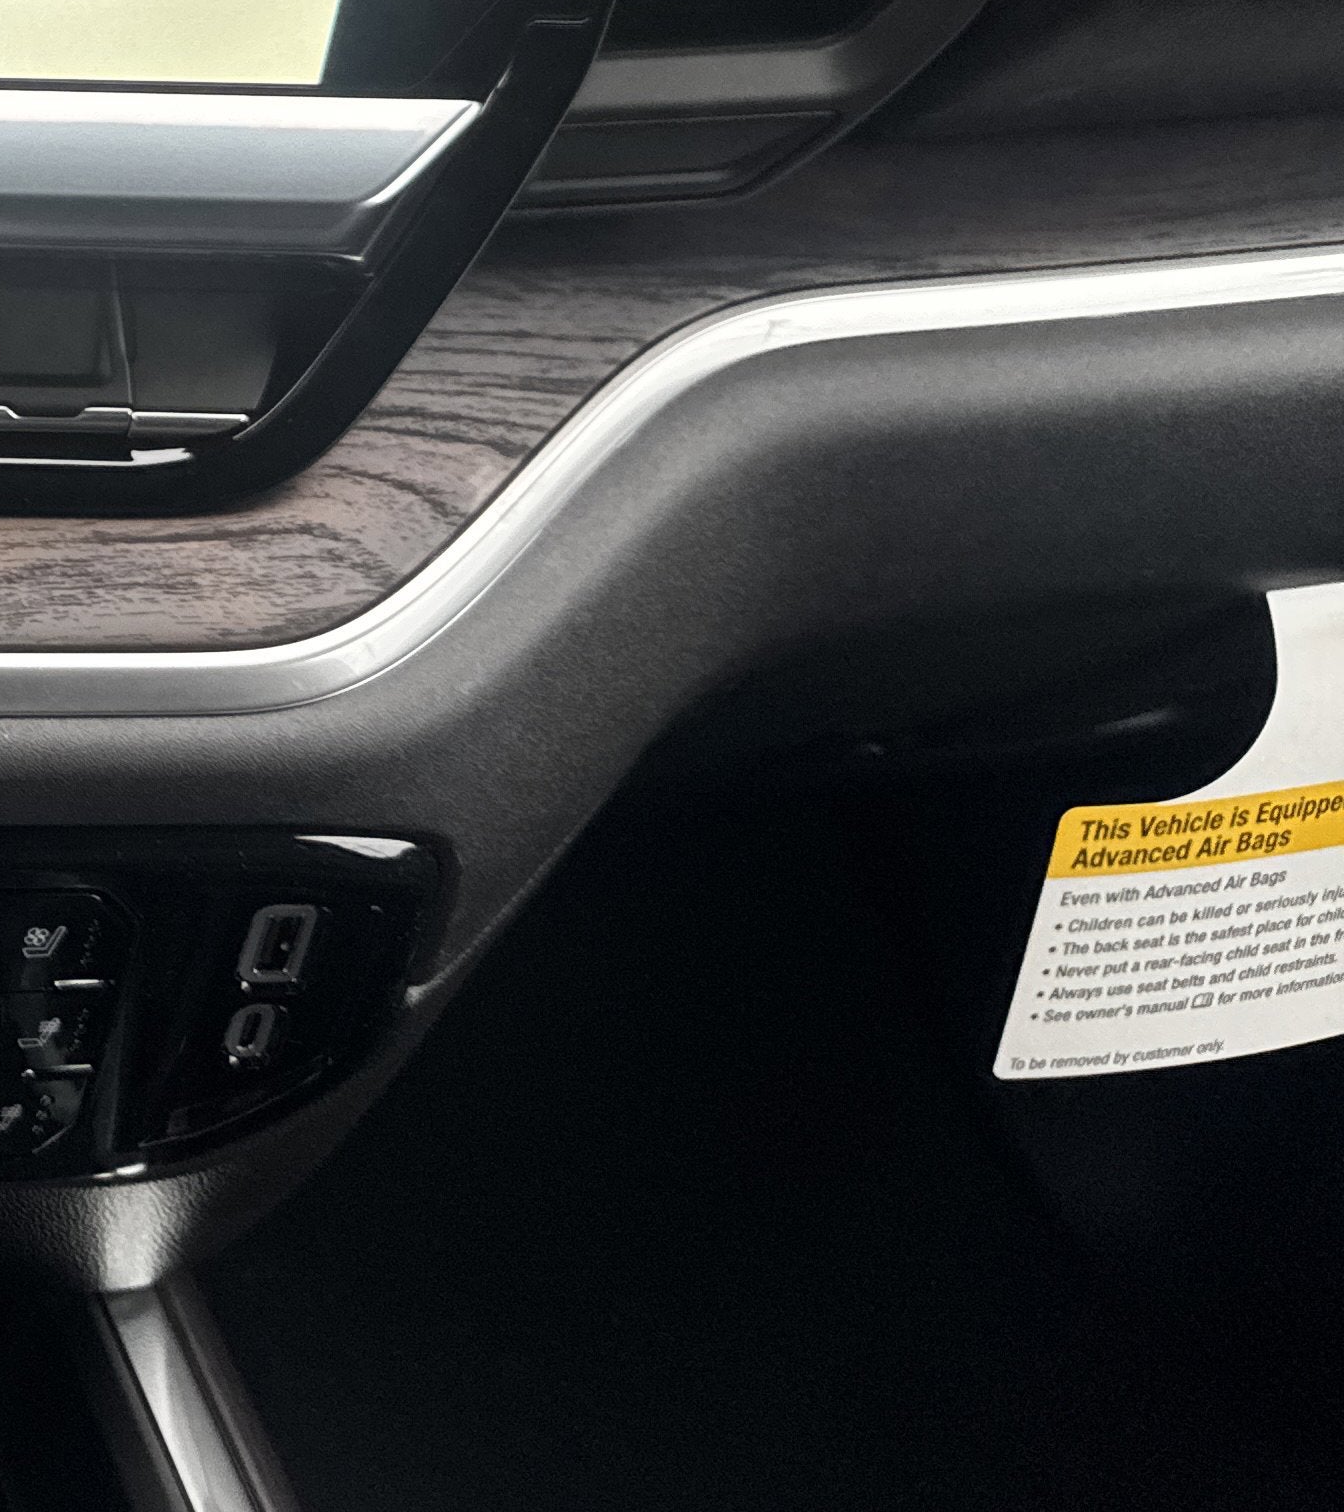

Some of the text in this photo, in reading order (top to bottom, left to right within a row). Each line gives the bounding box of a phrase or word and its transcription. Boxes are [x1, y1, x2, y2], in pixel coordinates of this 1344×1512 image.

[1081, 795, 1344, 842] This Vehicle is Equippe
[1071, 829, 1291, 869] Advanced Air Bags
[1060, 870, 1287, 906] Even with Advanced Air Bags
[1068, 917, 1133, 933] Children
[1137, 914, 1164, 928] can
[1169, 910, 1188, 924] be
[1192, 903, 1233, 921] killed
[1236, 903, 1252, 915] or
[1255, 890, 1318, 913] seriously
[1063, 941, 1089, 955] The
[1093, 938, 1129, 954] back
[1133, 935, 1165, 950] seat
[1168, 933, 1180, 946] is
[1184, 931, 1207, 944] the
[1211, 922, 1253, 940] safest
[1254, 918, 1292, 937] place
[1295, 914, 1315, 927] for
[1055, 964, 1100, 978] Never
[1102, 961, 1129, 977] put
[1131, 962, 1140, 972] a
[1144, 951, 1222, 972] rear-facing
[1225, 943, 1260, 962] child
[1261, 939, 1292, 956] seat
[1293, 936, 1306, 950] in
[1309, 932, 1330, 947] the
[1049, 987, 1103, 1001] Always
[1107, 984, 1133, 997] use
[1136, 979, 1169, 994] seat
[1171, 974, 1205, 989] belts
[1209, 968, 1236, 985] and
[1238, 962, 1272, 981] child
[1043, 1009, 1071, 1023] See
[1075, 1005, 1133, 1021] owner's
[1136, 997, 1189, 1015] manual
[1218, 991, 1237, 1005] for
[1239, 986, 1274, 1002] more
[1011, 1057, 1025, 1071] To
[1029, 1057, 1046, 1069] be
[1050, 1052, 1111, 1068] removed
[1113, 1051, 1130, 1065] by
[1132, 1044, 1195, 1062] customer
